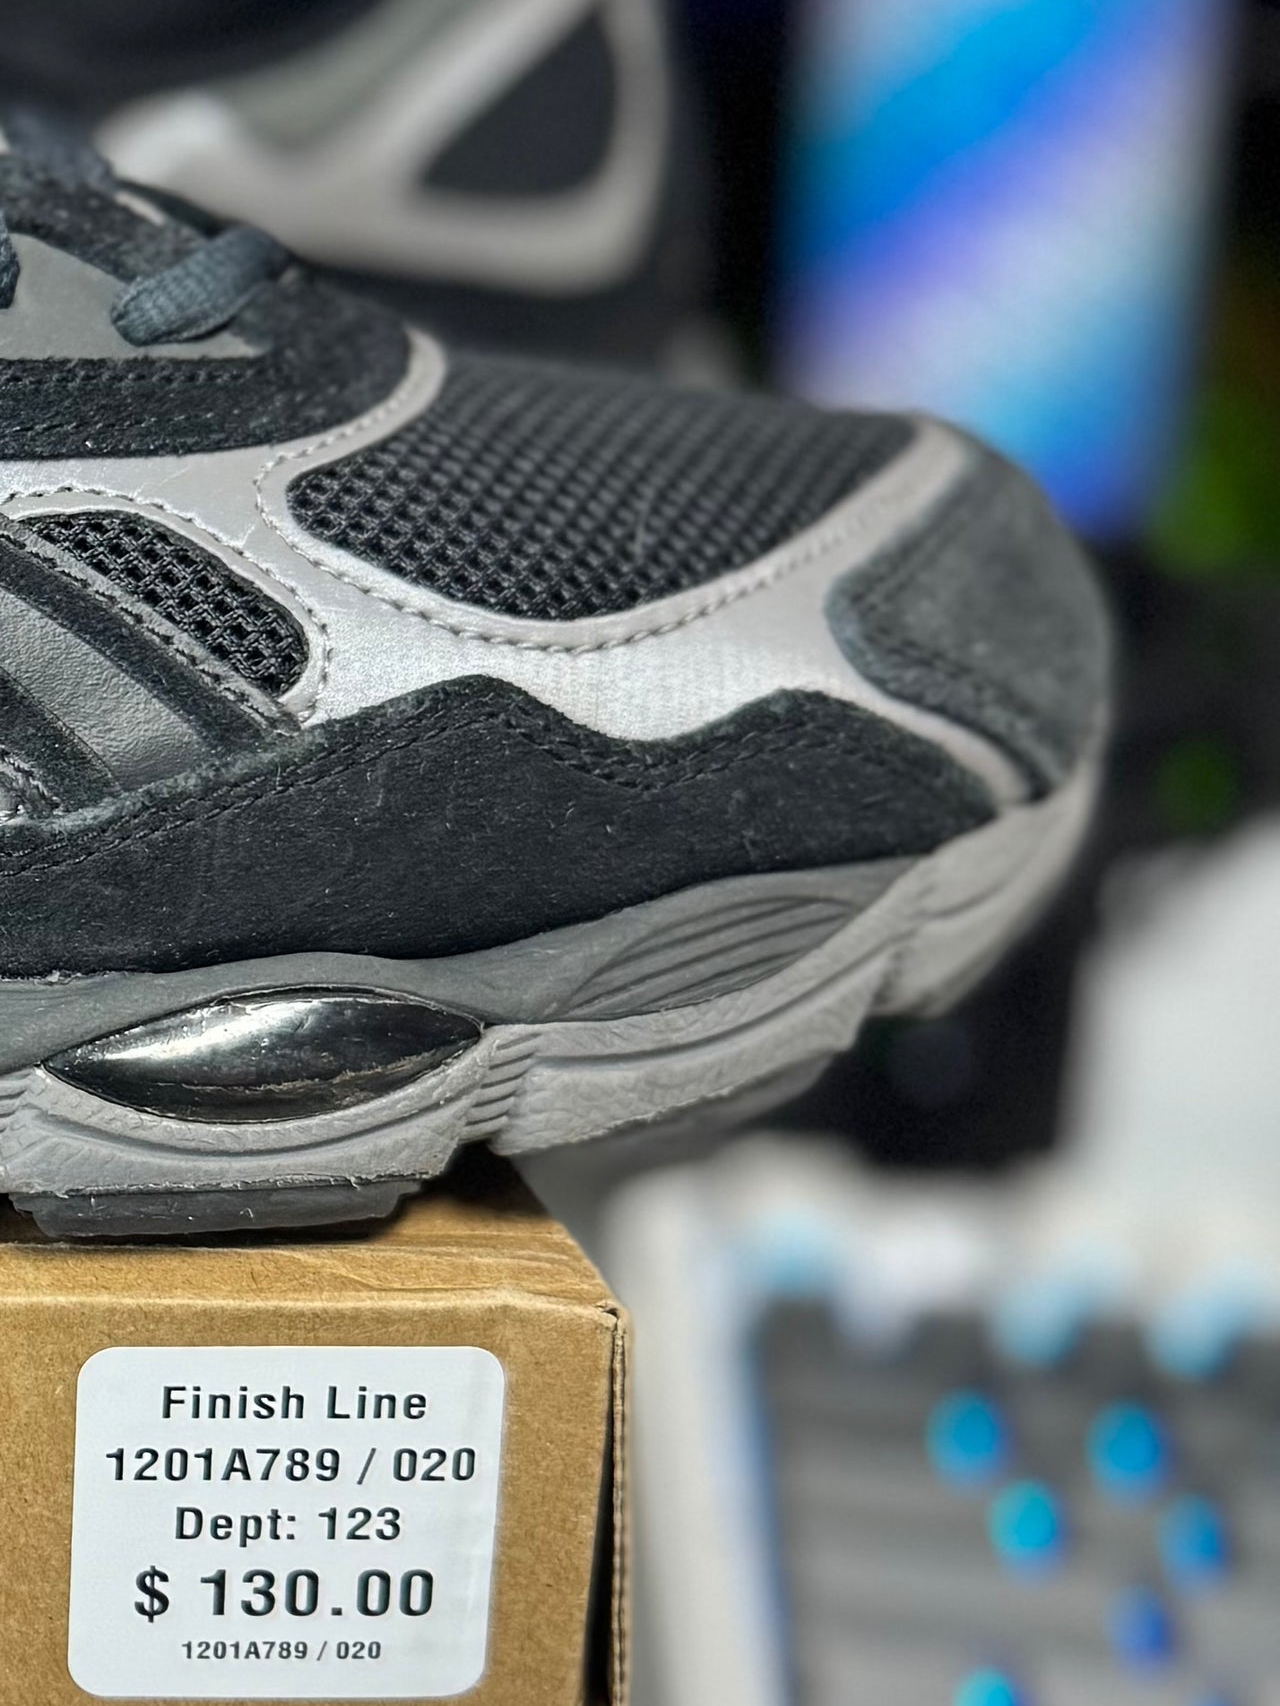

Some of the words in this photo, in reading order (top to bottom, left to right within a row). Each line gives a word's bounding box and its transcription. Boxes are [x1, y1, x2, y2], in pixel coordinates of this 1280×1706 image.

[161, 1384, 306, 1421] Finish
[325, 1384, 428, 1421] Line
[104, 1446, 341, 1483] 1201A789
[355, 1446, 378, 1487] /
[392, 1446, 477, 1483] 020
[174, 1505, 297, 1550] Dept:
[317, 1505, 402, 1542] 123
[133, 1564, 171, 1625] $
[199, 1568, 435, 1618] 130.00
[180, 1639, 310, 1661] 1201A789
[315, 1639, 329, 1663] /
[335, 1640, 383, 1661] 020
